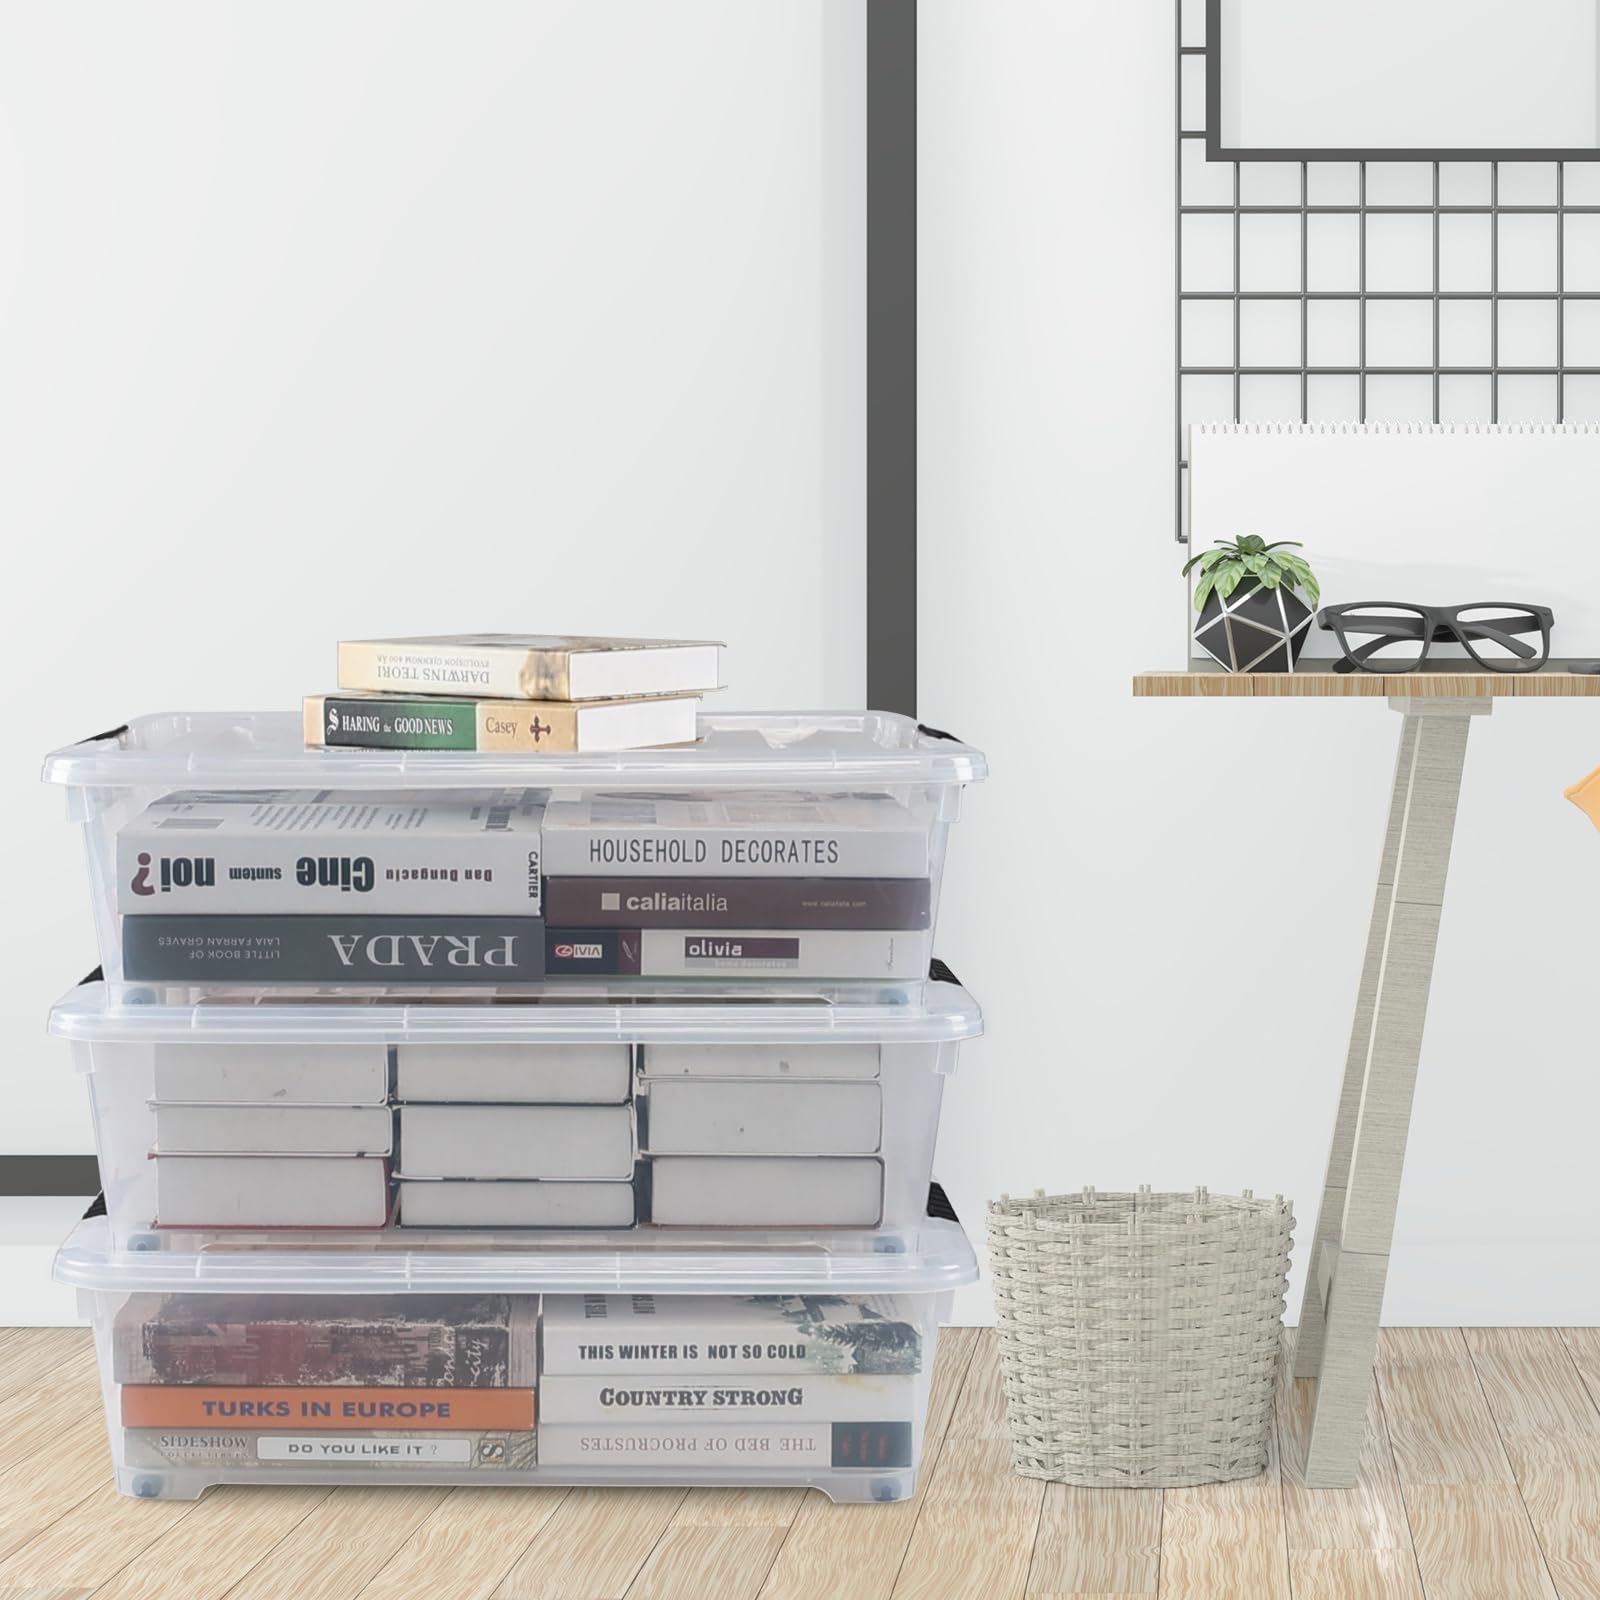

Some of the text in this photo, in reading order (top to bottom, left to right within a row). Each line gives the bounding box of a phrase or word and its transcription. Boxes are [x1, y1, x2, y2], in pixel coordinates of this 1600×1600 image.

[376, 666, 490, 685] DARWINS TEORI
[394, 717, 424, 734] GOOD
[424, 718, 454, 736] NEWS
[485, 717, 519, 736] Casey
[589, 839, 839, 864] HOUSEHOLD DECORATES
[228, 867, 283, 881] suntem
[295, 856, 376, 893] Cine
[464, 868, 493, 882] Dan
[528, 851, 539, 899] CARTIER
[626, 892, 728, 912] caliaitalia
[157, 937, 280, 947] LAIA FARRAN GRAVES
[327, 934, 519, 967] PRADA
[689, 939, 742, 957] olivia
[187, 950, 280, 959] LITTLE BOOK OF
[578, 1344, 807, 1360] THIS WINTER IS NOT SO COLD
[599, 1387, 803, 1407] COUNTRY STRONG
[202, 1400, 451, 1419] TURKS IN EUROPE
[160, 1435, 249, 1449] SIDESHOW
[288, 1443, 439, 1456] DO YOU LIKE IT ?
[580, 1437, 816, 1451] THE BED OF PROCRUSTES
